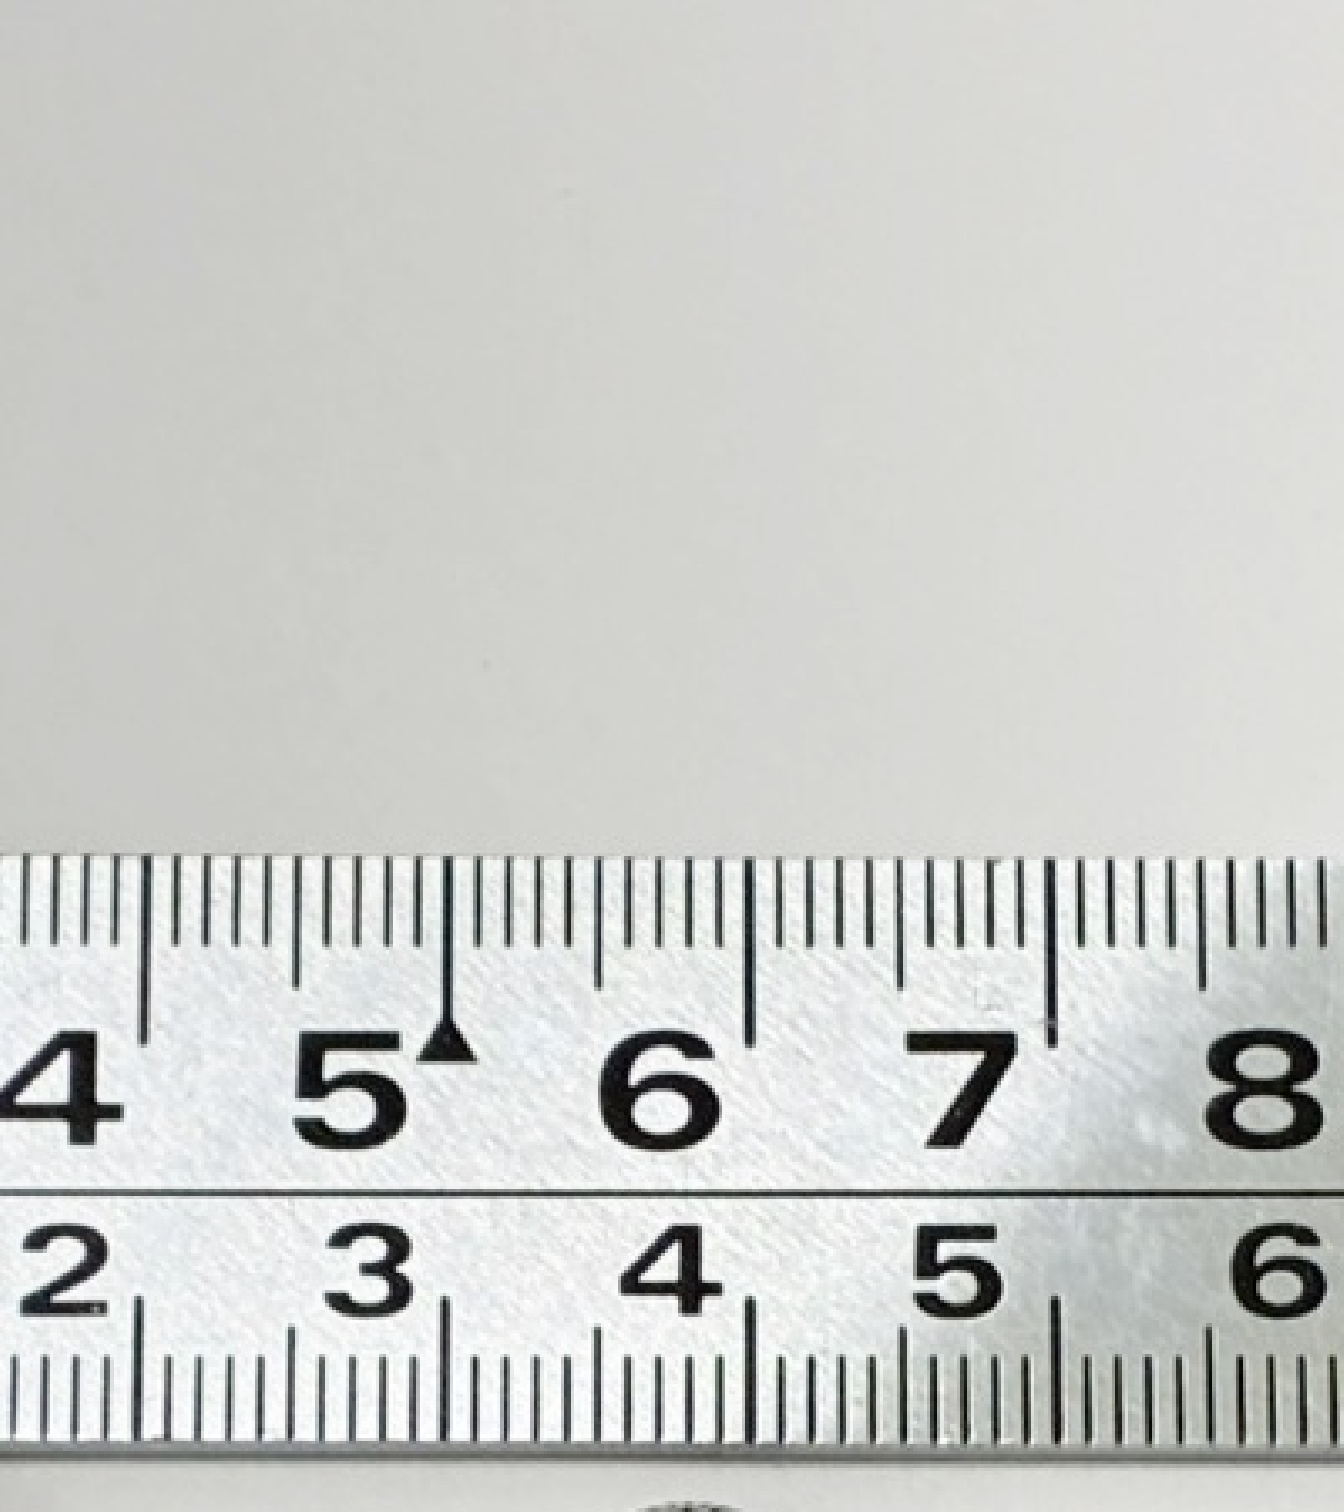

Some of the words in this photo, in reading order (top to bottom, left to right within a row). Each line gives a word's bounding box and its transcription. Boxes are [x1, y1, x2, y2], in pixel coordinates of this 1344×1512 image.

[292, 1031, 407, 1149] 5
[597, 1030, 721, 1152] 6
[905, 1031, 1017, 1149] 7
[1203, 1028, 1324, 1150] 8
[19, 1223, 109, 1316] 2
[323, 1222, 415, 1317] 3
[618, 1223, 723, 1316] 4
[910, 1224, 1003, 1318] 5
[1229, 1223, 1327, 1319] 6
